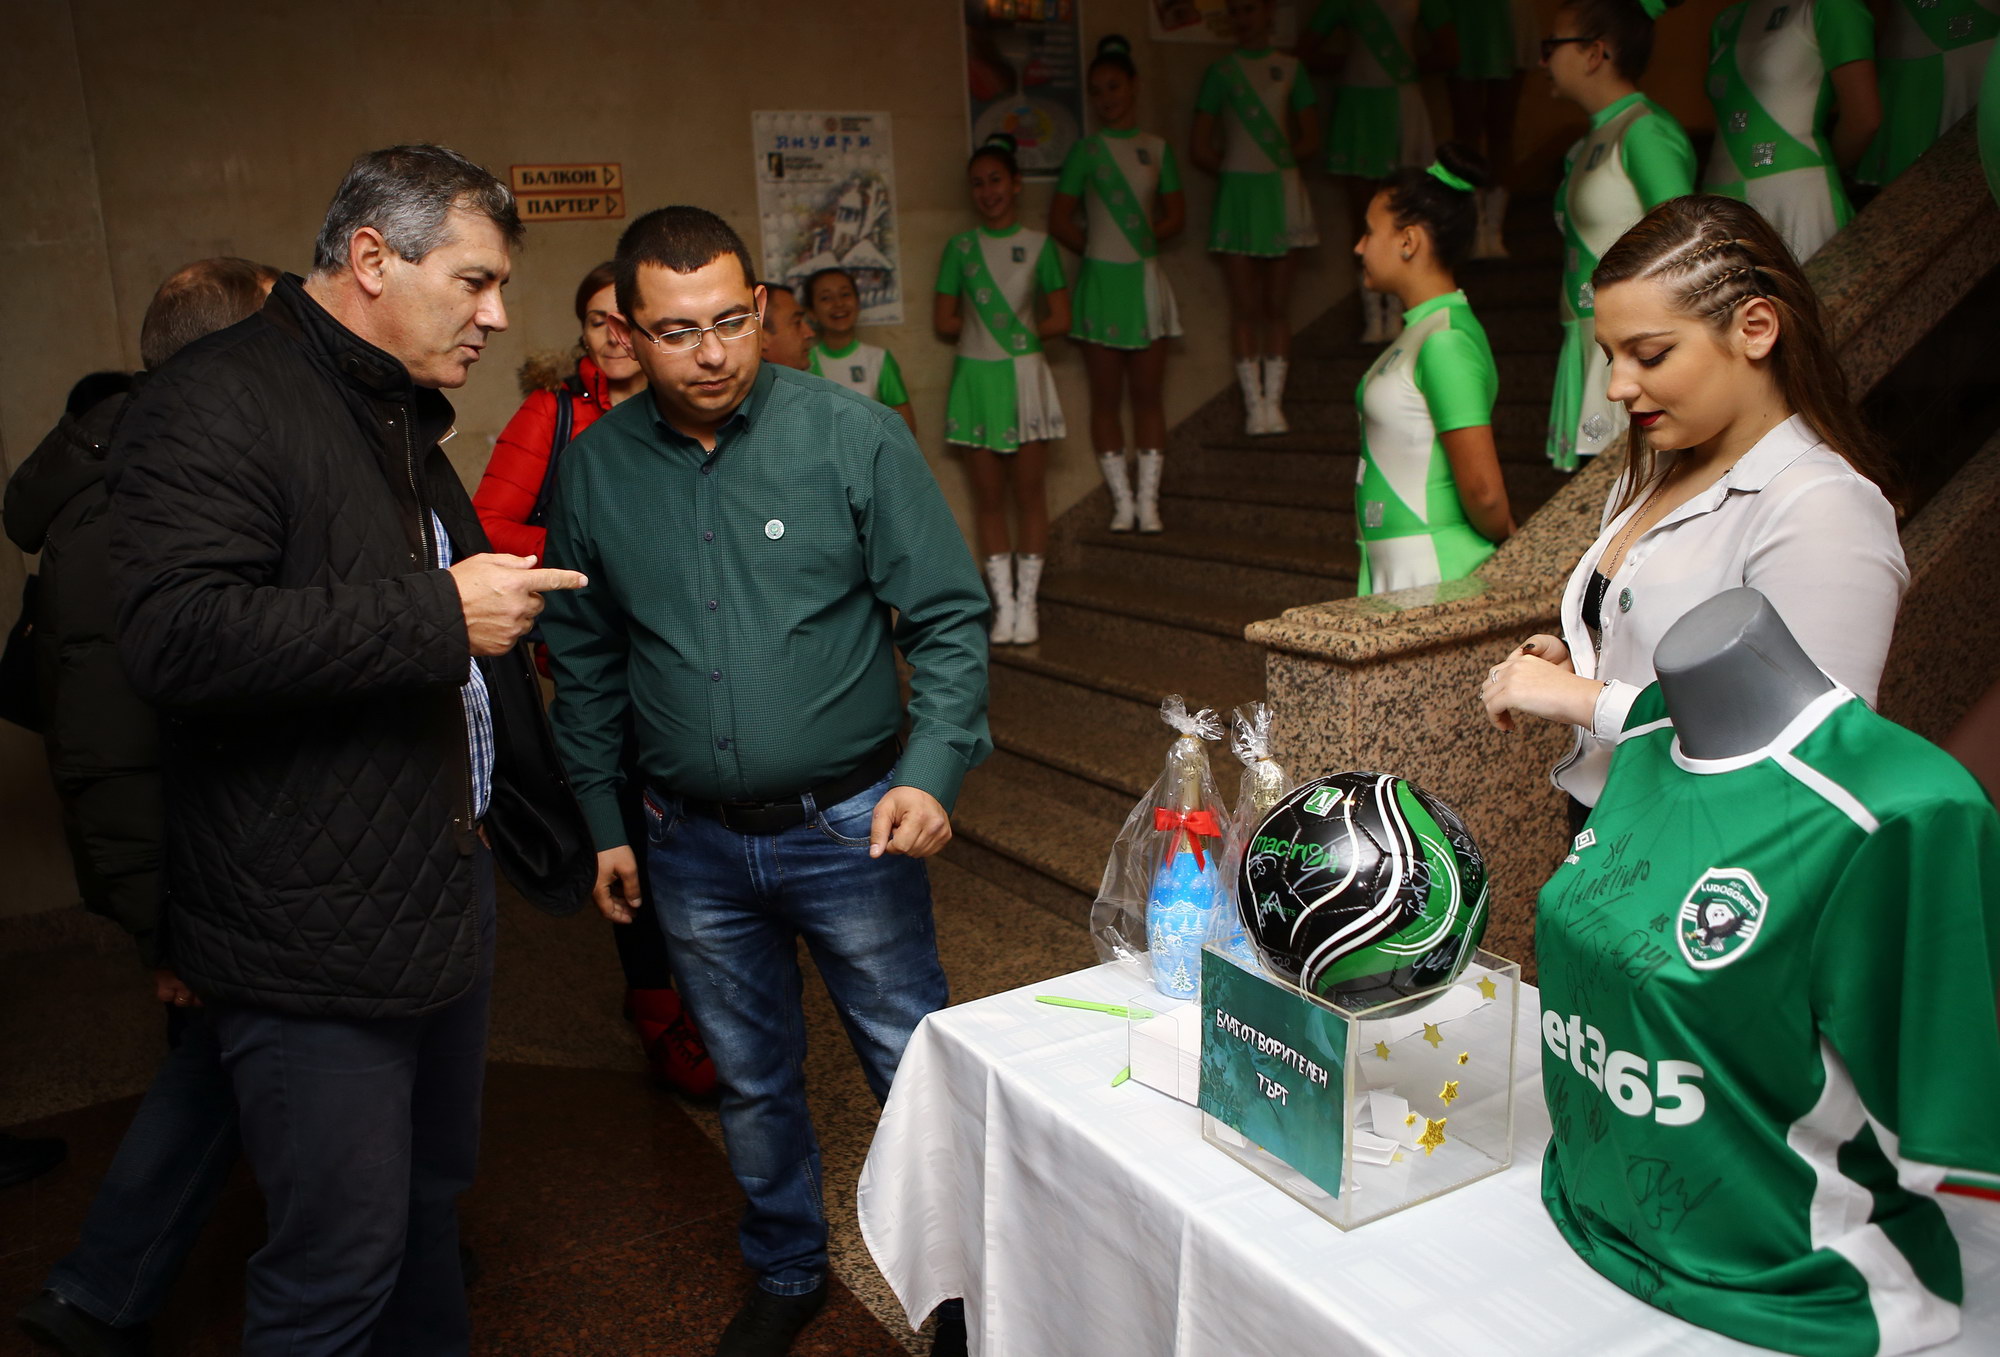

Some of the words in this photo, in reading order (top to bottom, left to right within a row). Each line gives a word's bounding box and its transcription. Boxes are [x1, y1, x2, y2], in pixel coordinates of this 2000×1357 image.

[522, 170, 596, 185] БАЛКОН
[527, 198, 600, 214] ПАРТЕР
[1252, 835, 1340, 874] macron
[1700, 883, 1759, 918] LUDOGORETS
[1216, 1008, 1328, 1089] БЛАГОТВОРИТЕЛЕН
[1542, 1009, 1706, 1126] et365
